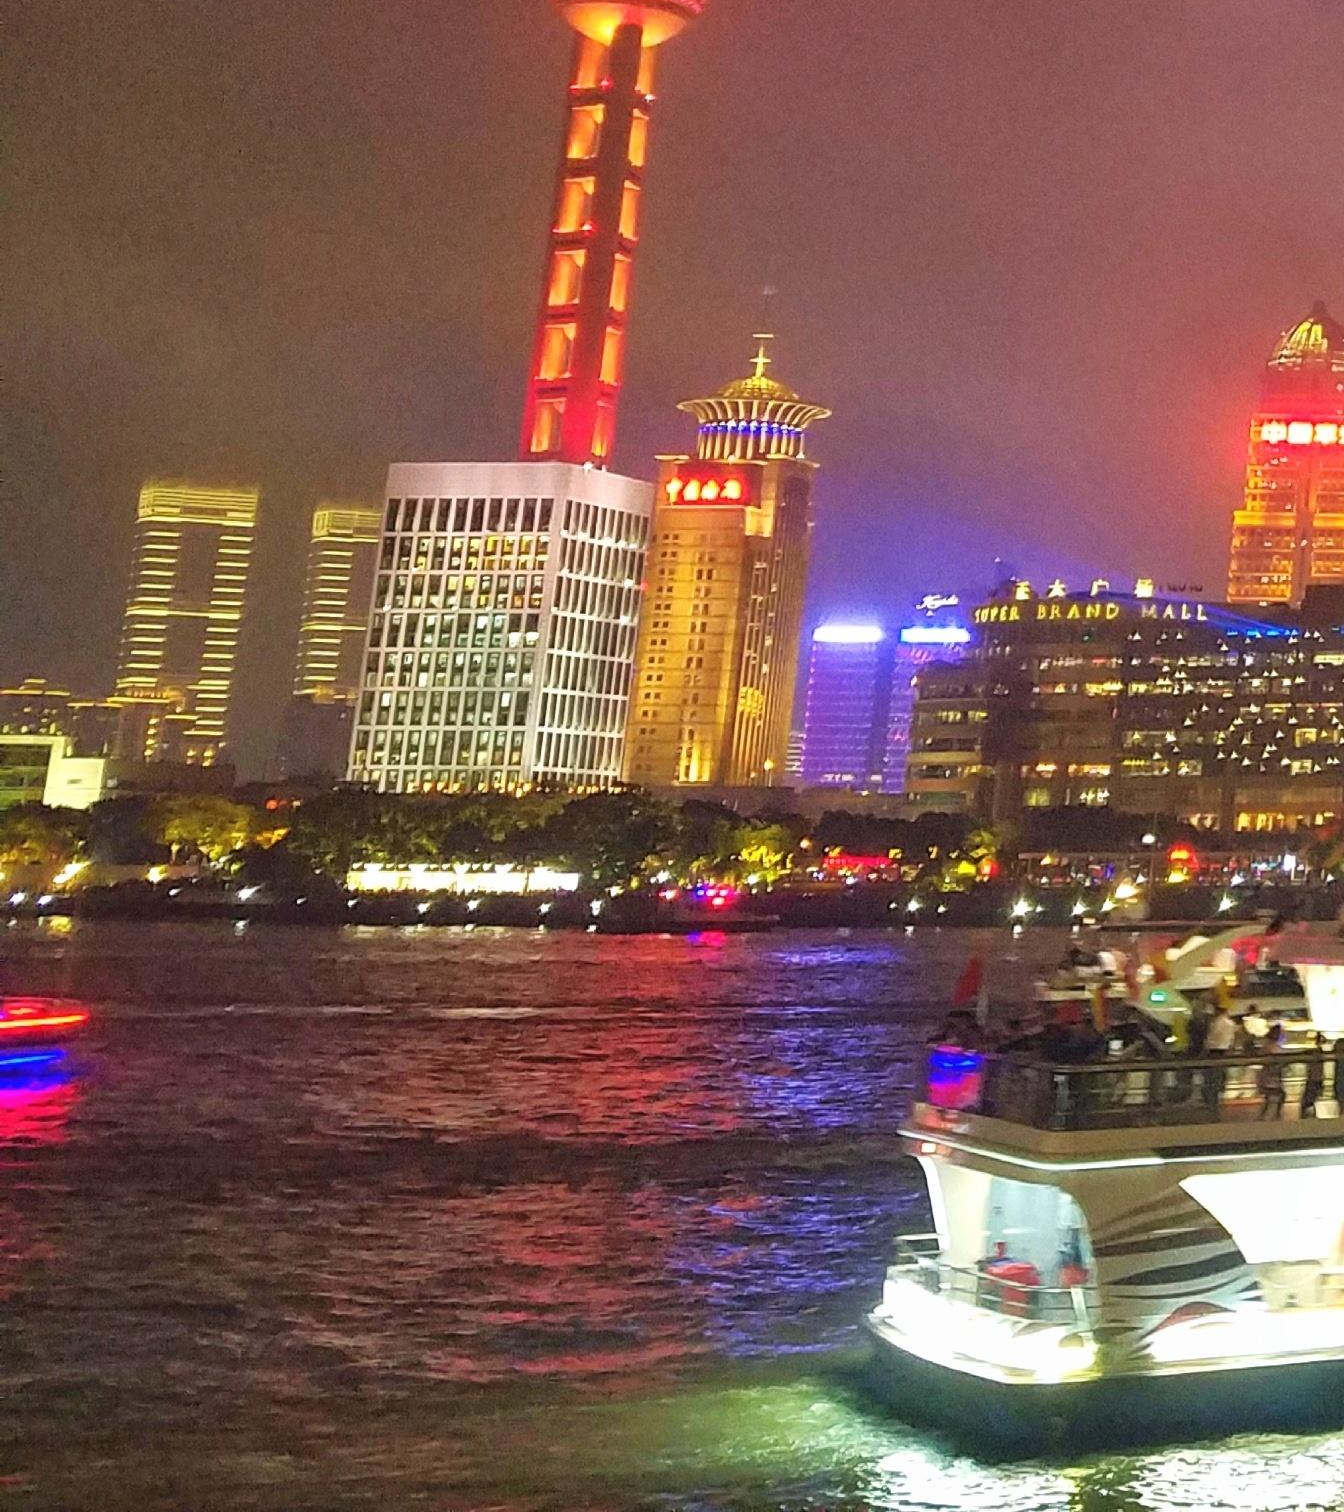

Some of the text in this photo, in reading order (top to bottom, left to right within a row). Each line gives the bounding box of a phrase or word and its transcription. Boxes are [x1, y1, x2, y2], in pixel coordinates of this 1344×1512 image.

[974, 602, 1209, 624] SUPER BRAND MALL
